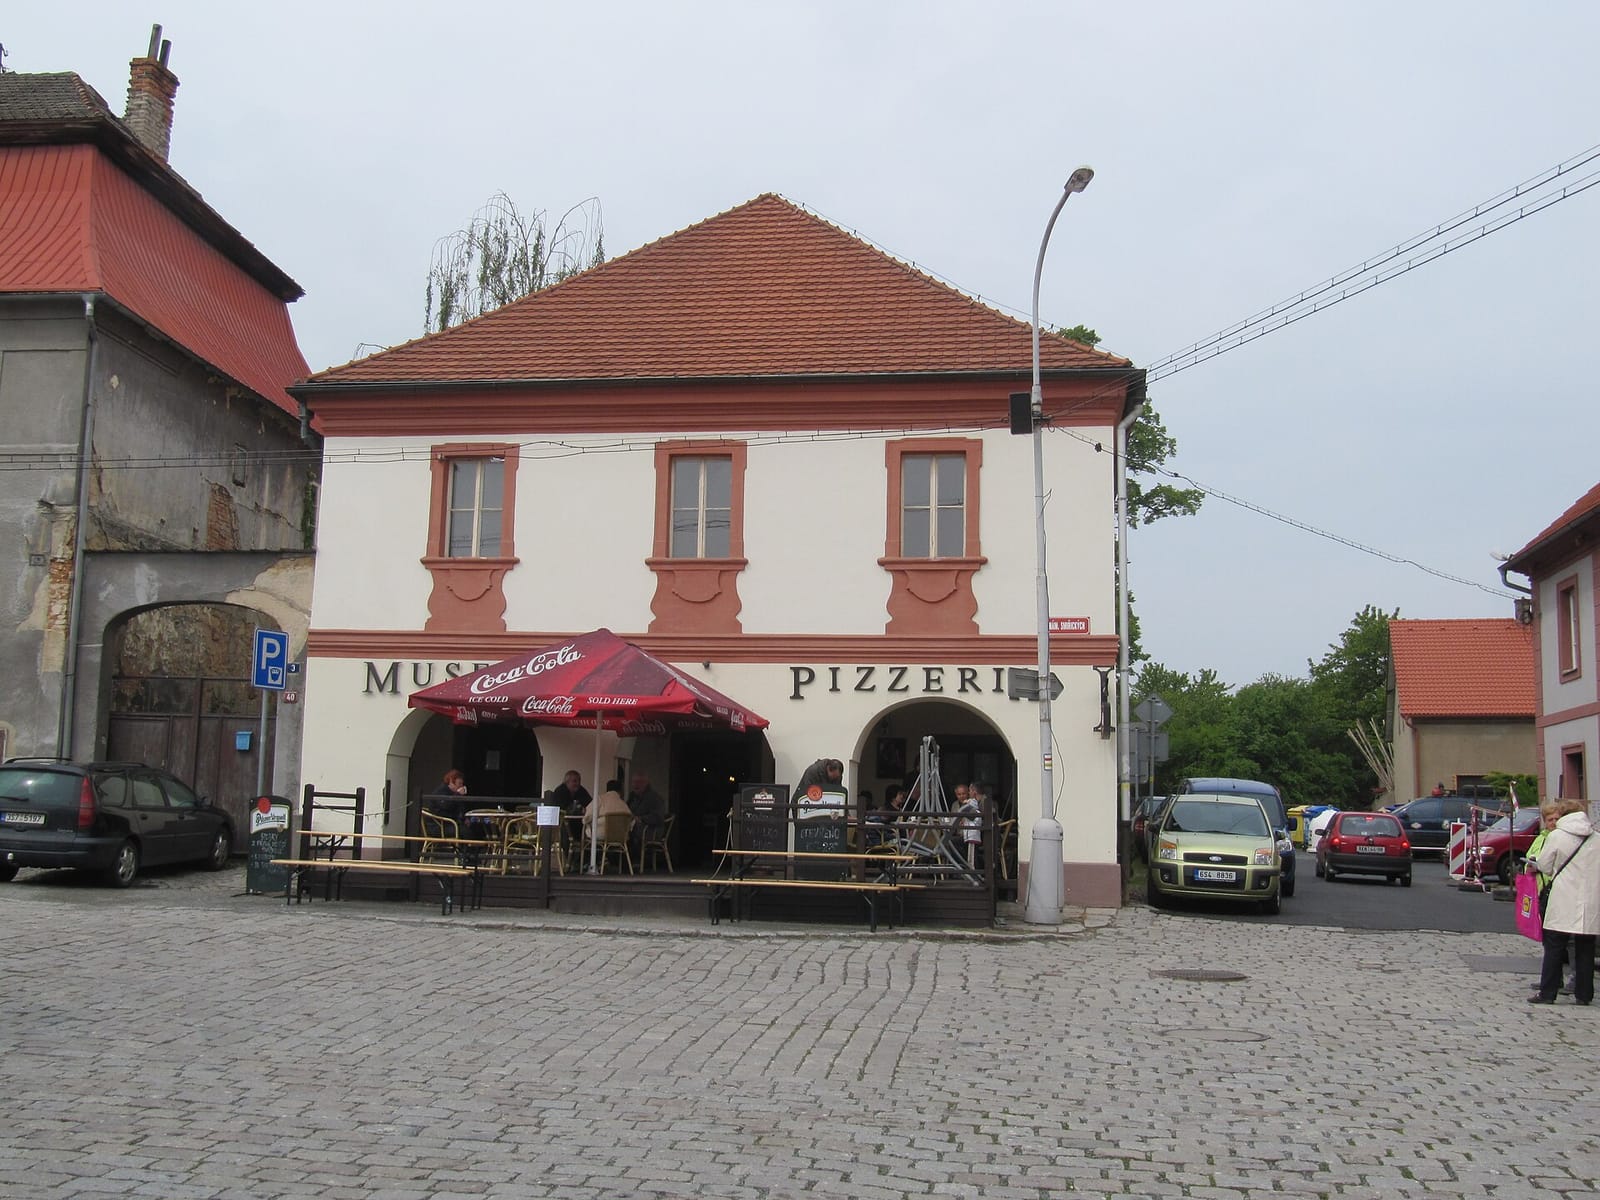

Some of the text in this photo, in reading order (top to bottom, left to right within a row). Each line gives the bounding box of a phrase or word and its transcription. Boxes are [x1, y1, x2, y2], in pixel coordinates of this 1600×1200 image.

[261, 637, 281, 670] P
[470, 644, 584, 695] Coca-Cola
[789, 666, 1005, 700] PIZZERI
[286, 693, 295, 701] 40
[468, 695, 509, 704] ICE COLD
[521, 695, 577, 714] Coca-Cola
[587, 696, 639, 705] SOLD HERE
